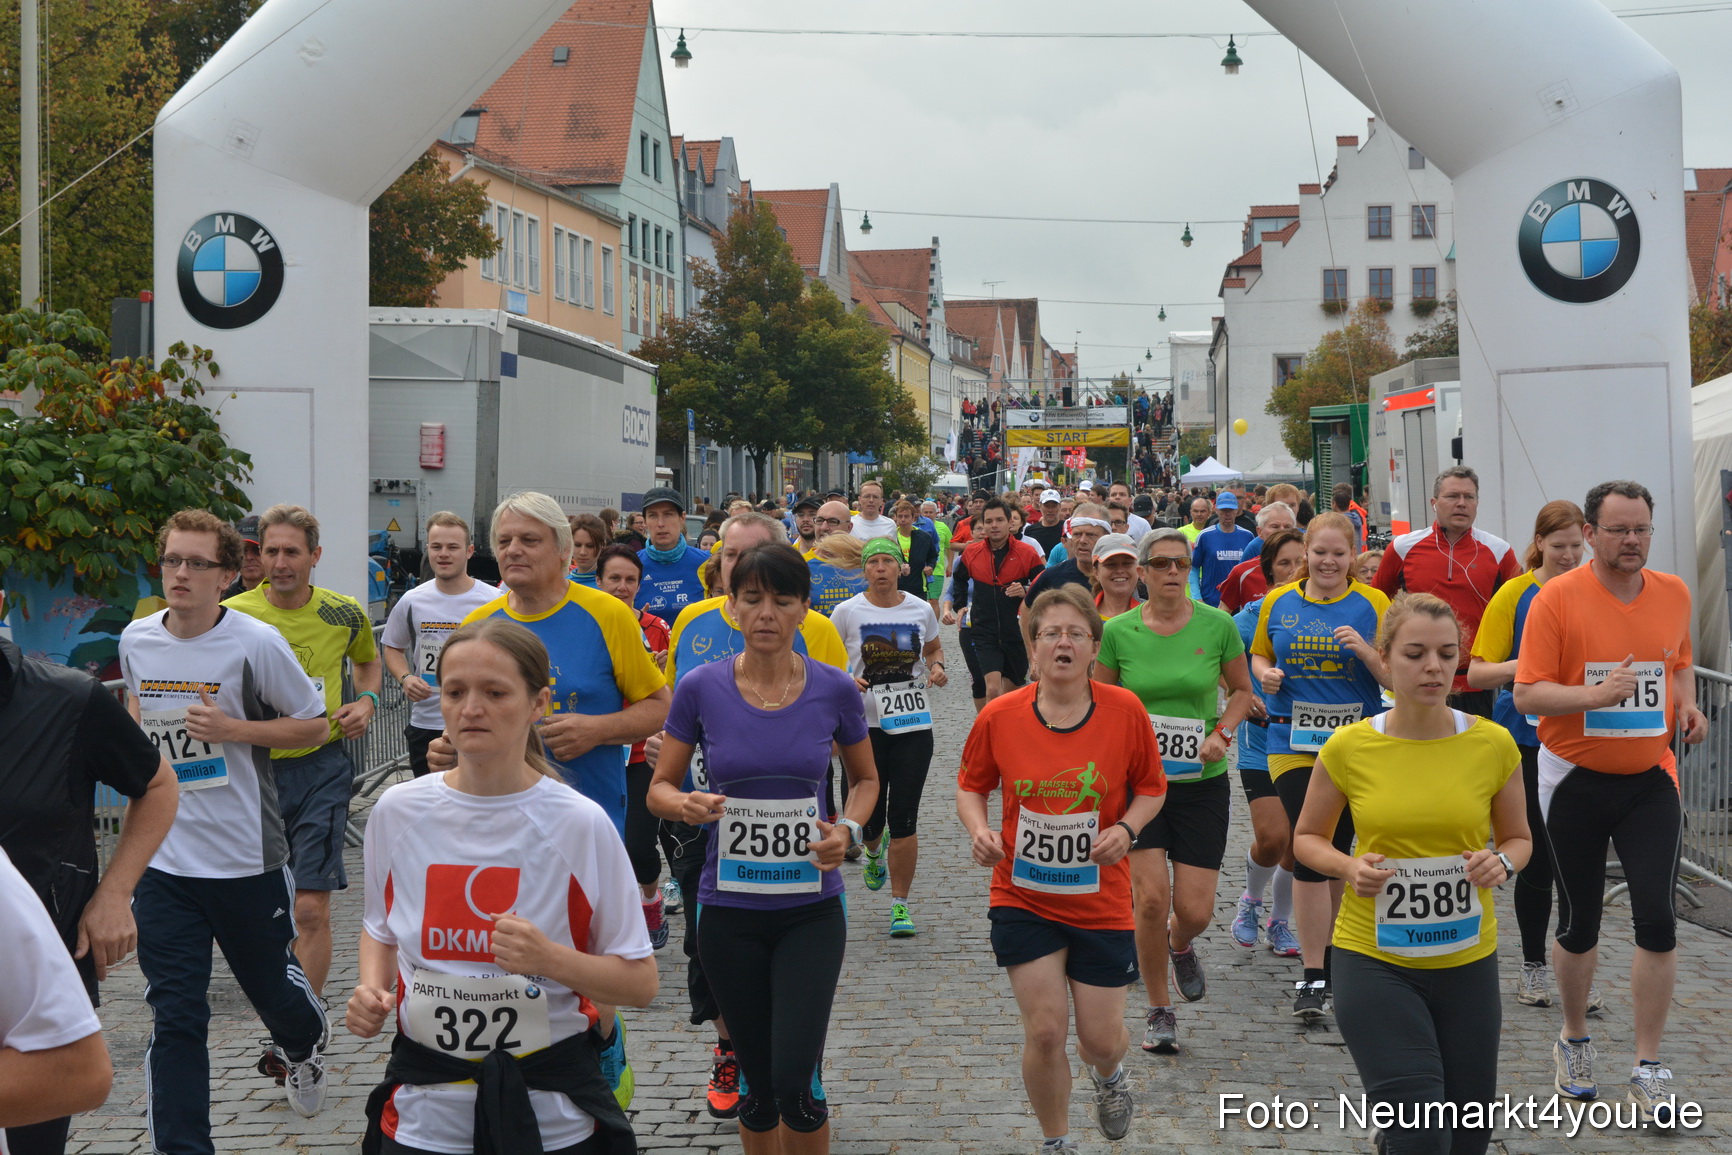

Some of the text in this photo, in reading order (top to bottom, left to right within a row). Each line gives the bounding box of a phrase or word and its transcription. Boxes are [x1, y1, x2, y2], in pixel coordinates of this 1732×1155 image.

[1528, 181, 1631, 224] BMW
[184, 215, 275, 253] BMW
[622, 404, 650, 447] BOCK
[1047, 432, 1088, 442] START
[677, 594, 688, 602] FR
[864, 643, 878, 651] 11.
[882, 692, 925, 715] 2406
[143, 716, 186, 726] PARTL Neuma
[894, 716, 920, 726] Claudia
[1161, 722, 1193, 732] Neumarkt
[1311, 733, 1328, 745] Agn
[1013, 780, 1036, 797] 12.
[1039, 780, 1077, 789] MAISEL'S
[1037, 788, 1079, 798] FunRun
[723, 806, 803, 818] PARTL Neumarkt
[1020, 813, 1085, 831] PARTL Neumarkt
[729, 821, 811, 858] 2588
[1022, 829, 1091, 864] 2509
[737, 865, 801, 881] Germaine
[1029, 866, 1080, 883] Christine
[1414, 865, 1464, 878] Neumarkt
[1386, 878, 1471, 919] 2589
[428, 927, 493, 954] DKM
[1406, 928, 1458, 943] Yvonne
[413, 982, 520, 1002] PARTL Neumarkt
[434, 1005, 522, 1052] 322
